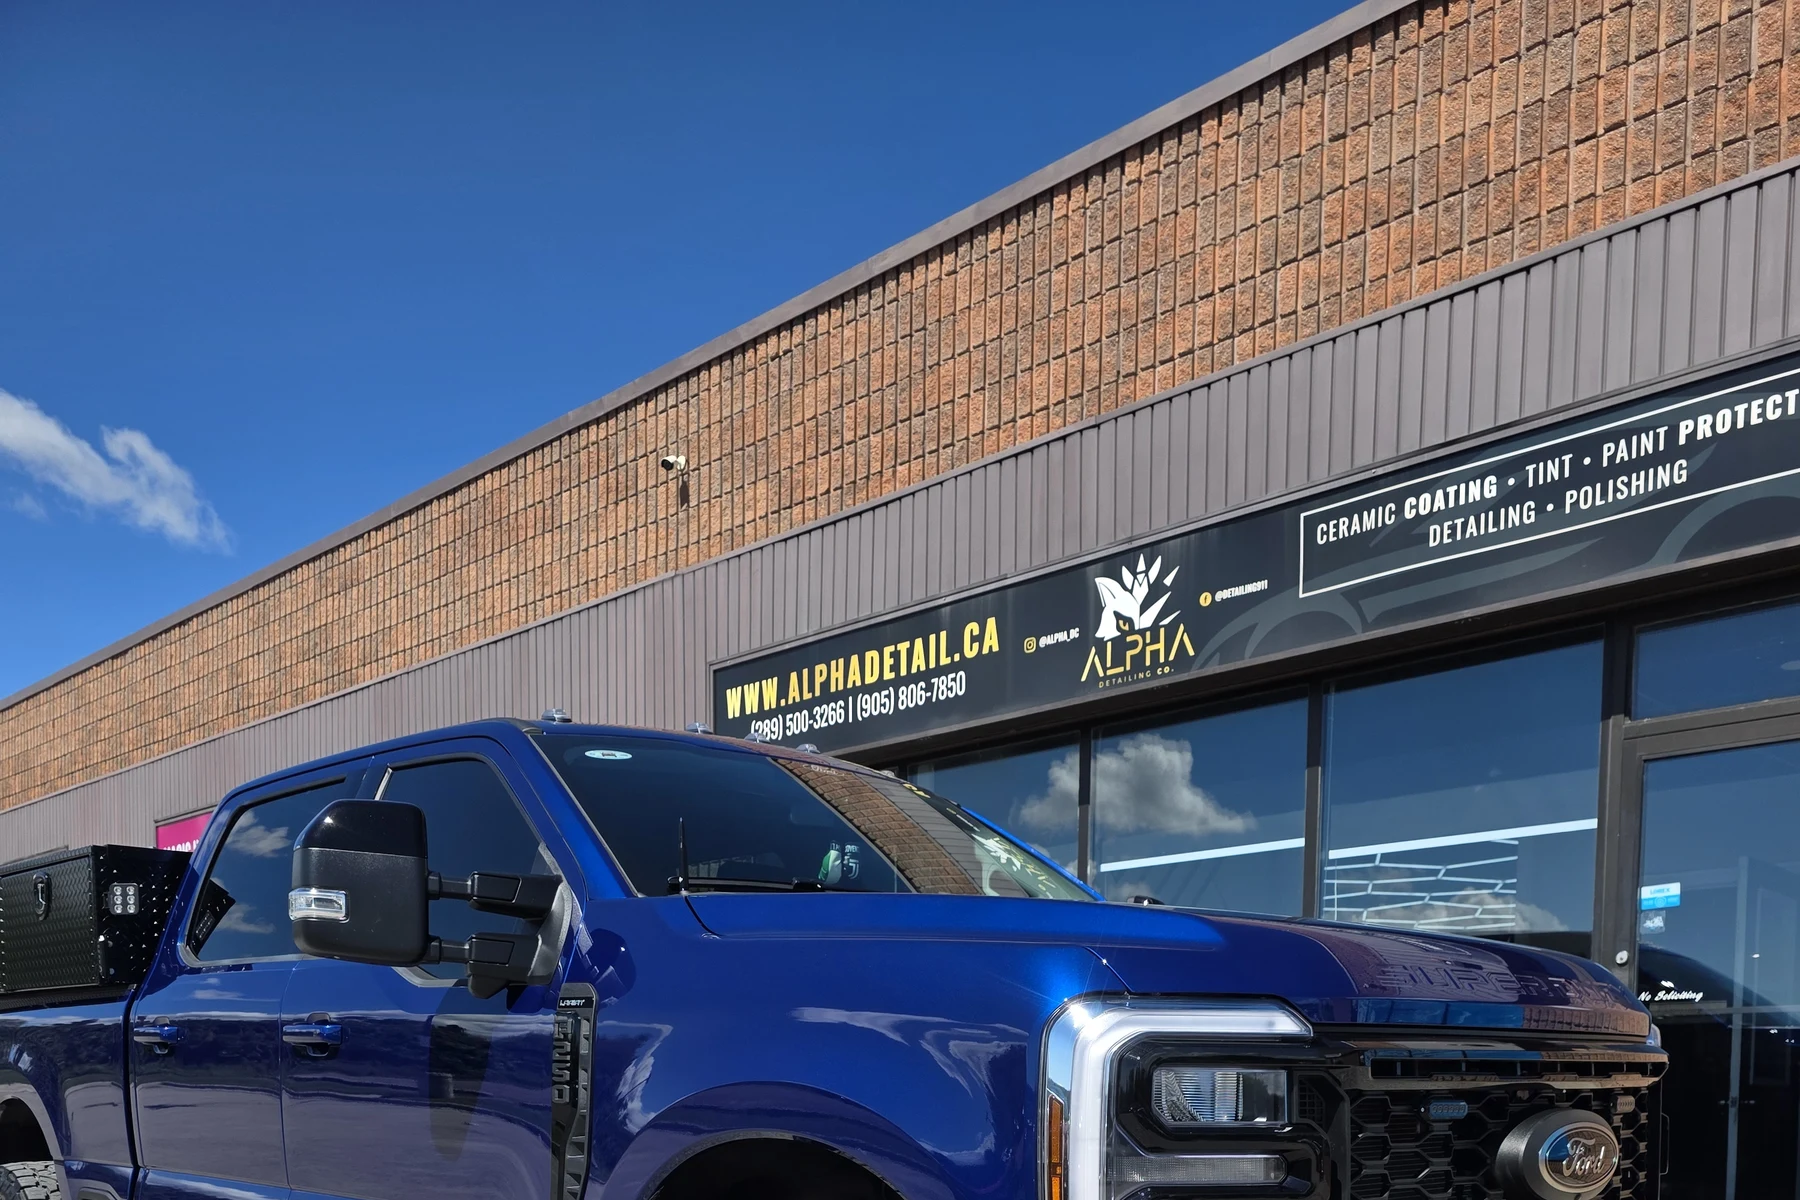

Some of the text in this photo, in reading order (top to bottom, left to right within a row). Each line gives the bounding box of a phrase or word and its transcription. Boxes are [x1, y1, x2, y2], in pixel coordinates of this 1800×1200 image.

[1315, 388, 1799, 546] CERAMIC COATING TINT PAINT PROTECT
[1428, 458, 1689, 548] DETAILING POLISHING
[1214, 579, 1269, 602] @DETAILING911
[1038, 627, 1080, 648] @ALPHA_DC
[1080, 622, 1196, 682] ALPHA
[725, 615, 1001, 720] WWW.ALPHADETAIL.CA
[1098, 665, 1175, 689] DETAILING CO.
[785, 699, 846, 737] 500-3266
[856, 687, 895, 723] (905)
[897, 671, 967, 712] 806-7850
[1637, 990, 1704, 1003] No Soliciting
[1562, 1136, 1606, 1177] Ford
